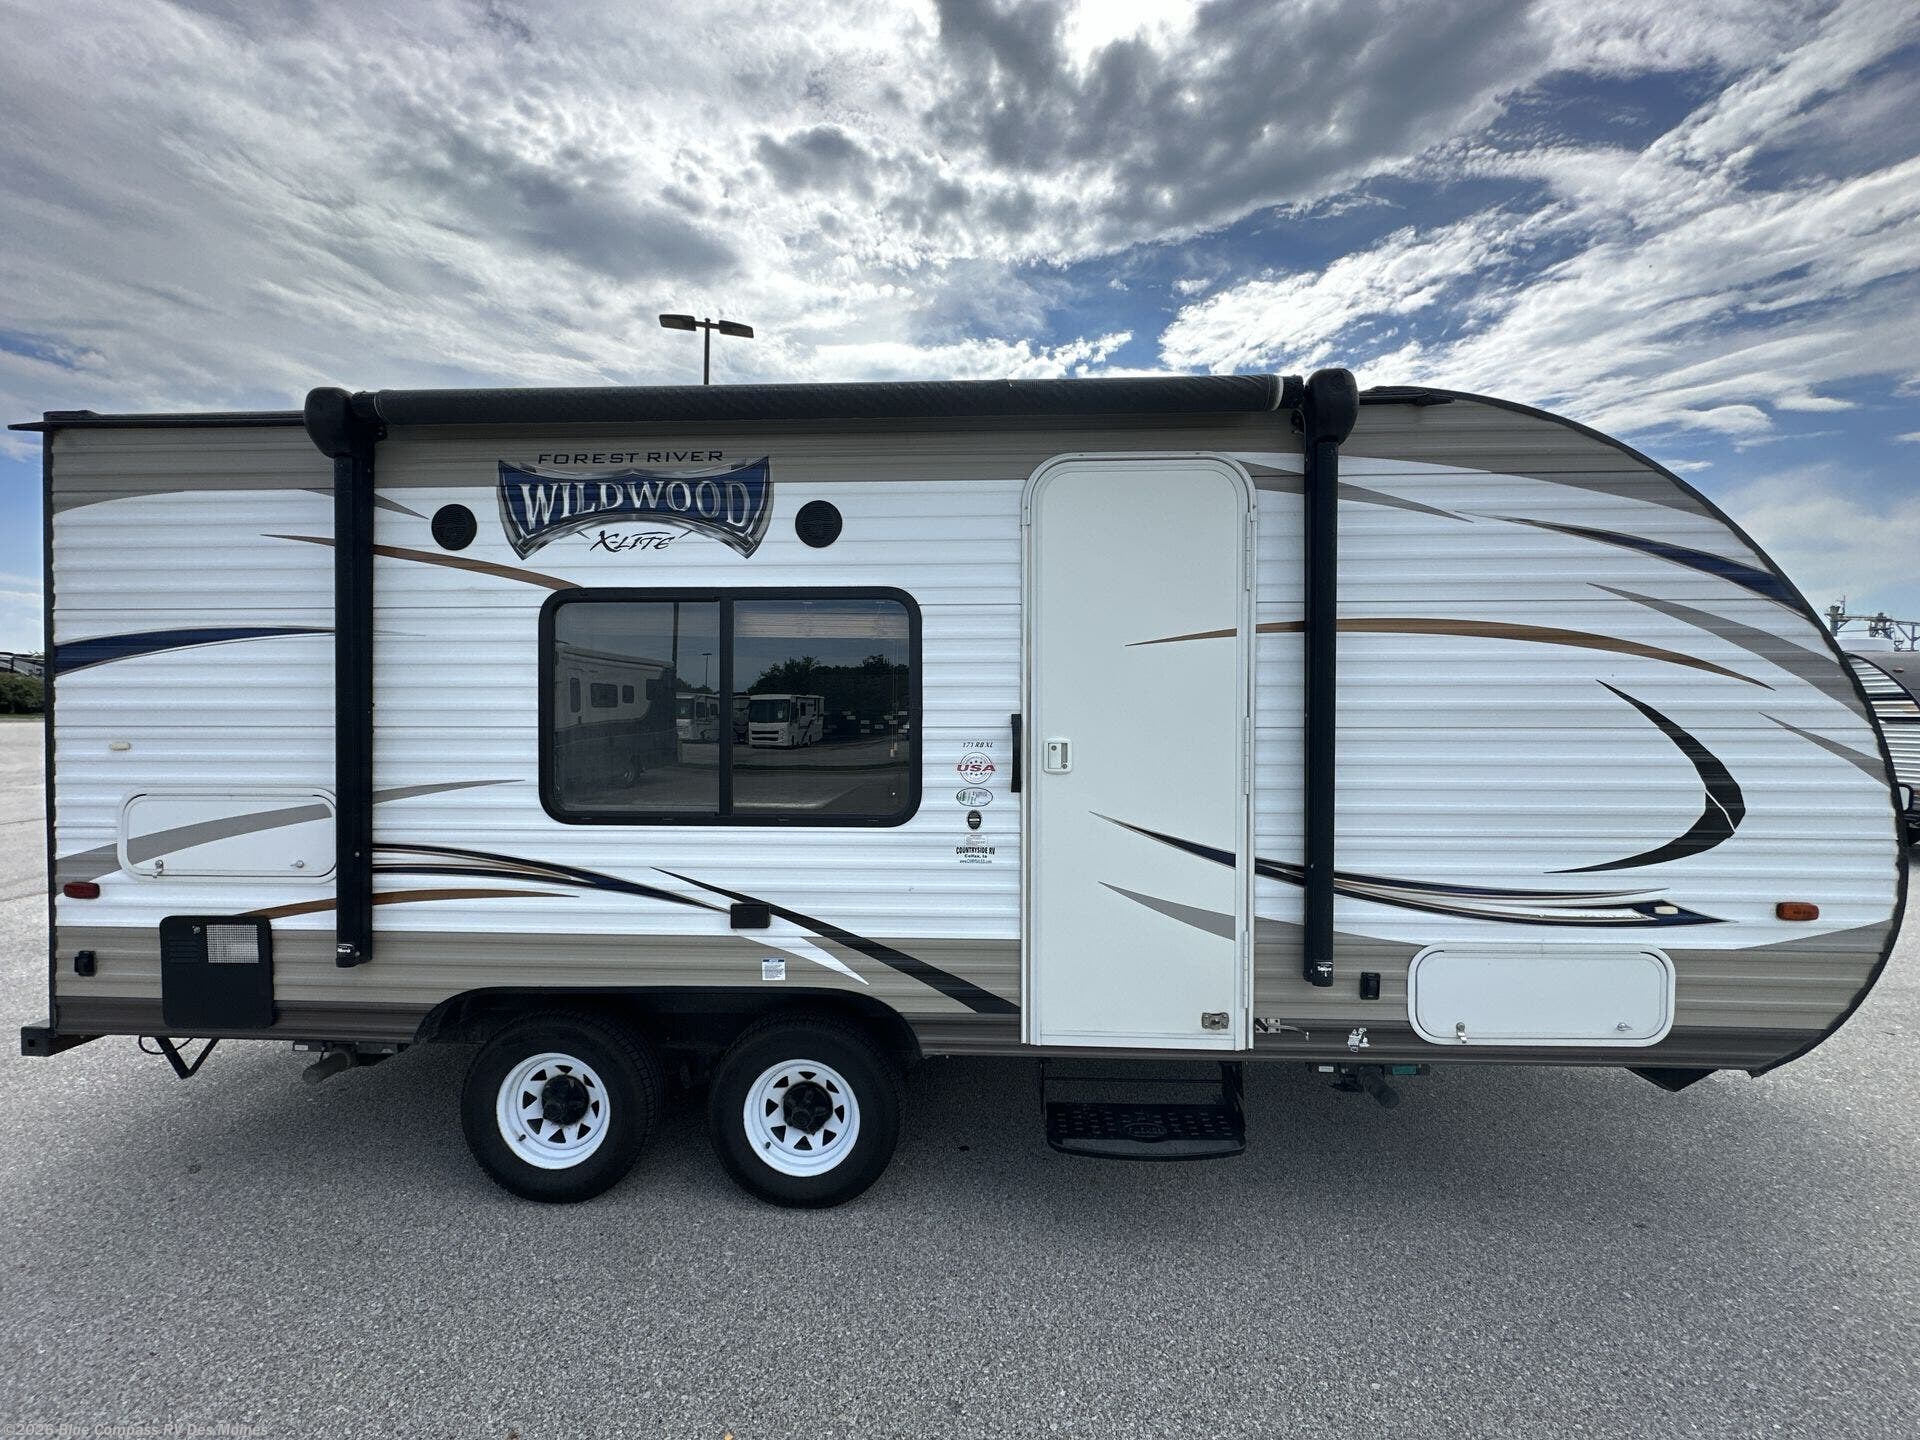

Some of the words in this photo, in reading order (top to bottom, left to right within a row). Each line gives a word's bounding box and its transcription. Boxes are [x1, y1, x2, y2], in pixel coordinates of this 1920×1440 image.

[538, 453, 639, 465] FOREST
[647, 451, 723, 463] RIVER
[519, 481, 751, 530] WILDWOOD
[590, 530, 675, 552] X-LITE
[957, 764, 996, 772] USA
[956, 846, 988, 854] COUNTRYSIDE
